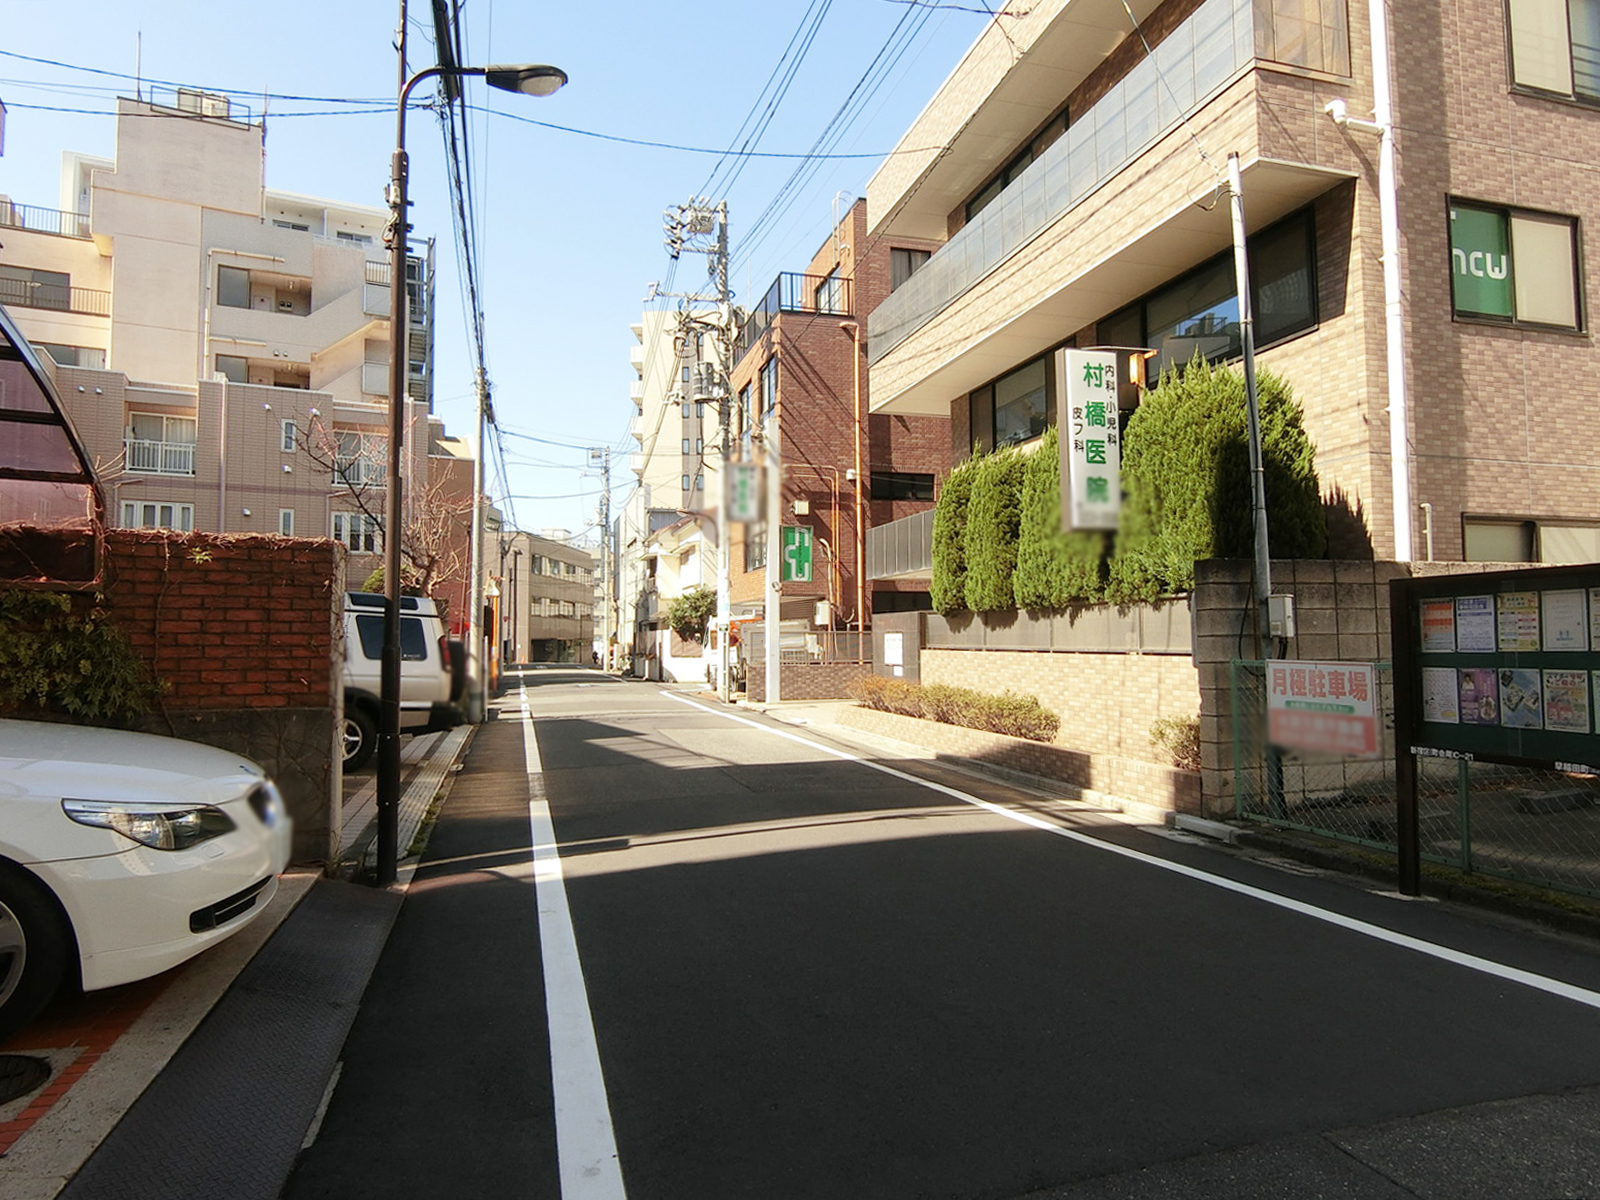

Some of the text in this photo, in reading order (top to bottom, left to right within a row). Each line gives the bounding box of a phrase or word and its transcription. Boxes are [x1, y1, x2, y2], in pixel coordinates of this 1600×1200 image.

[1072, 406, 1085, 453] 皮フ科
[1083, 361, 1109, 503] 村橋医院
[1272, 668, 1368, 702] 月極駐車場
